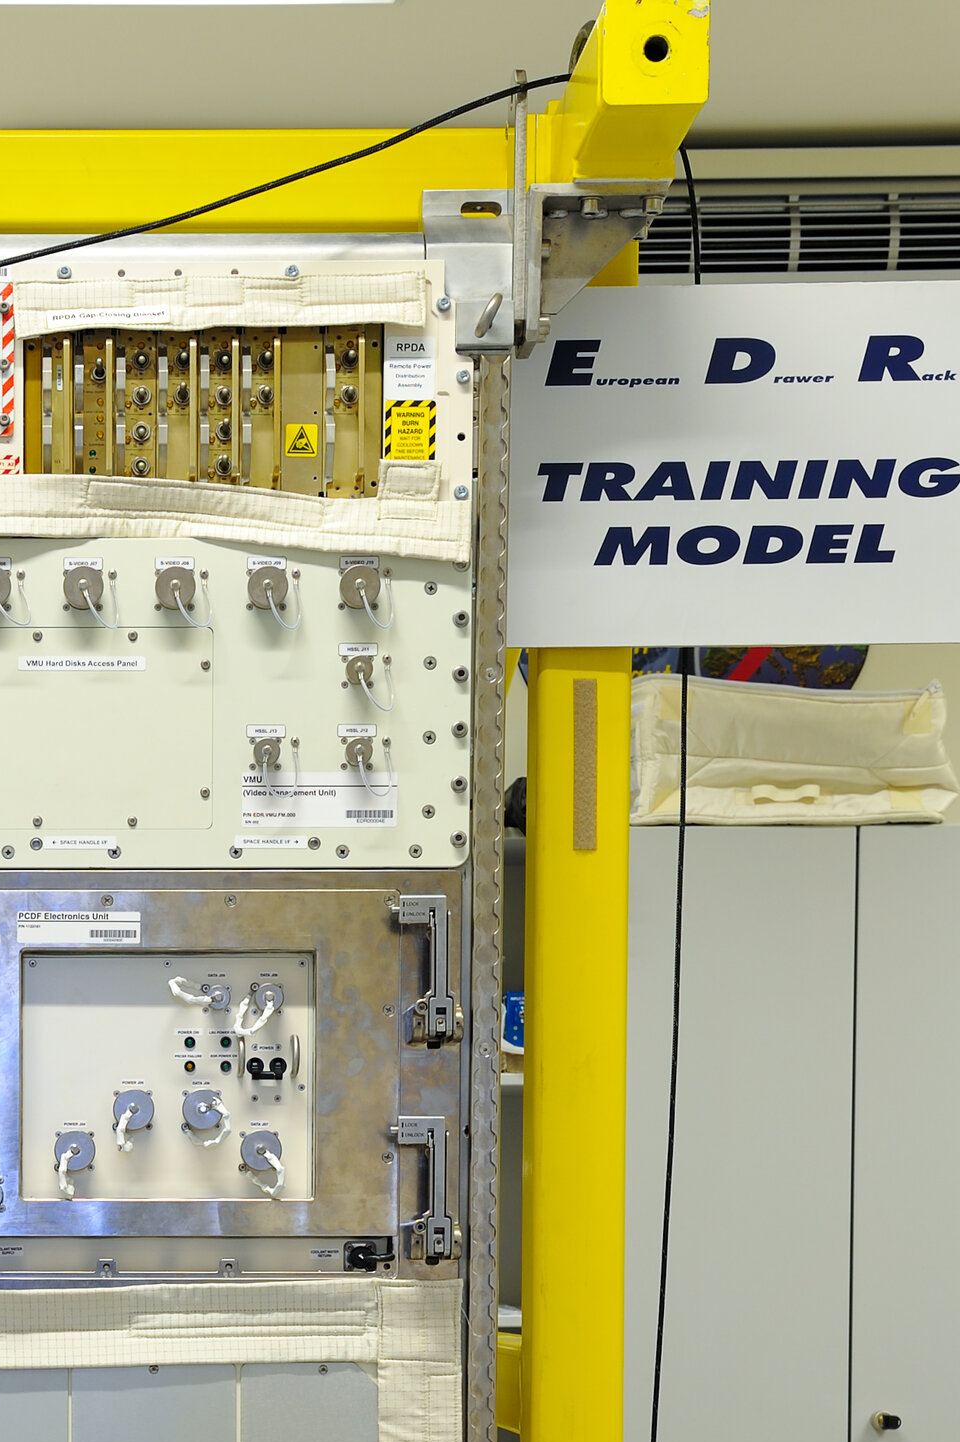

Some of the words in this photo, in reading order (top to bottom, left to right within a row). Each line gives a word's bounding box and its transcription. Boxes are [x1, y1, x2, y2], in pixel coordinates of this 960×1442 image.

[396, 343, 425, 352] RPDA
[537, 457, 960, 502] TRAINING
[593, 524, 896, 566] MODEL
[242, 789, 267, 797] (Video
[318, 789, 337, 797] Unit)
[18, 912, 42, 920] PCDF
[44, 912, 90, 920] Electronics
